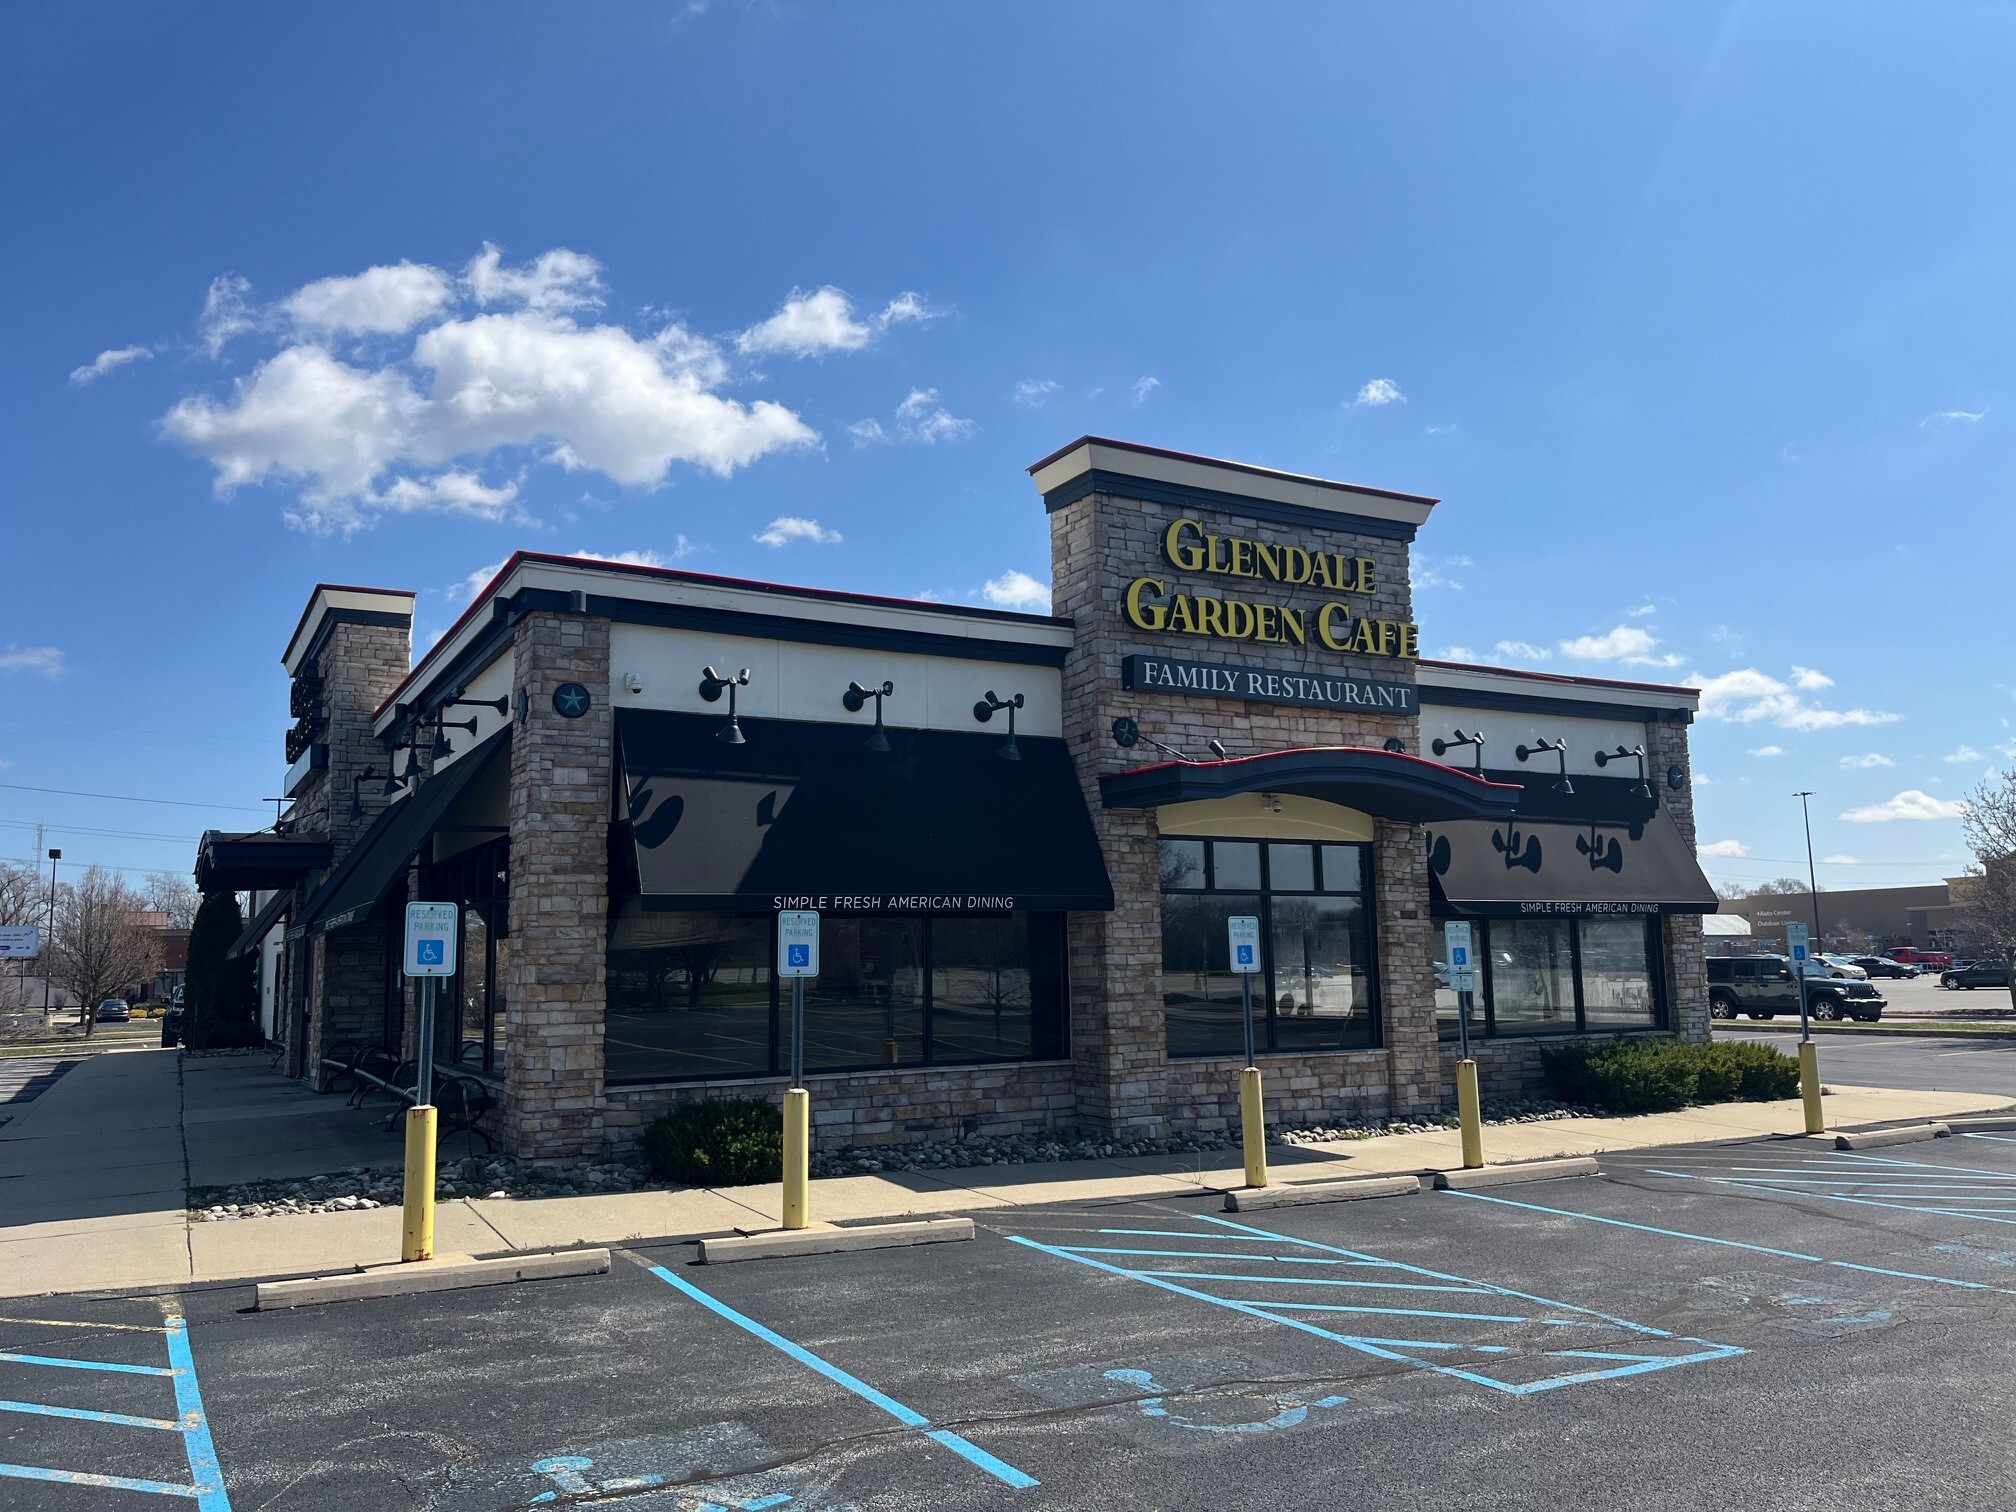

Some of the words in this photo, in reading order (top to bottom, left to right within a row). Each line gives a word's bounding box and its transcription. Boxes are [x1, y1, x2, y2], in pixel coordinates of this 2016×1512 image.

[1162, 518, 1377, 595] GLENDALE
[1123, 577, 1306, 646] GARDEN
[1315, 601, 1419, 659] CAFE
[1143, 661, 1240, 692] FAMILY
[1247, 673, 1411, 708] RESTAURANT
[773, 896, 828, 909] SIMPLE
[834, 896, 881, 909] FRESH
[887, 896, 962, 909] AMERICAN
[967, 896, 1014, 909] DINING
[1520, 902, 1552, 913] SIMPLE
[1555, 902, 1582, 913] FRESH
[1585, 903, 1628, 913] AMERICAN
[1631, 903, 1659, 913] DINING
[410, 909, 454, 919] RESERVED
[414, 922, 449, 931] PARKING
[782, 917, 816, 926] RESERVED
[785, 928, 813, 937] PARKING
